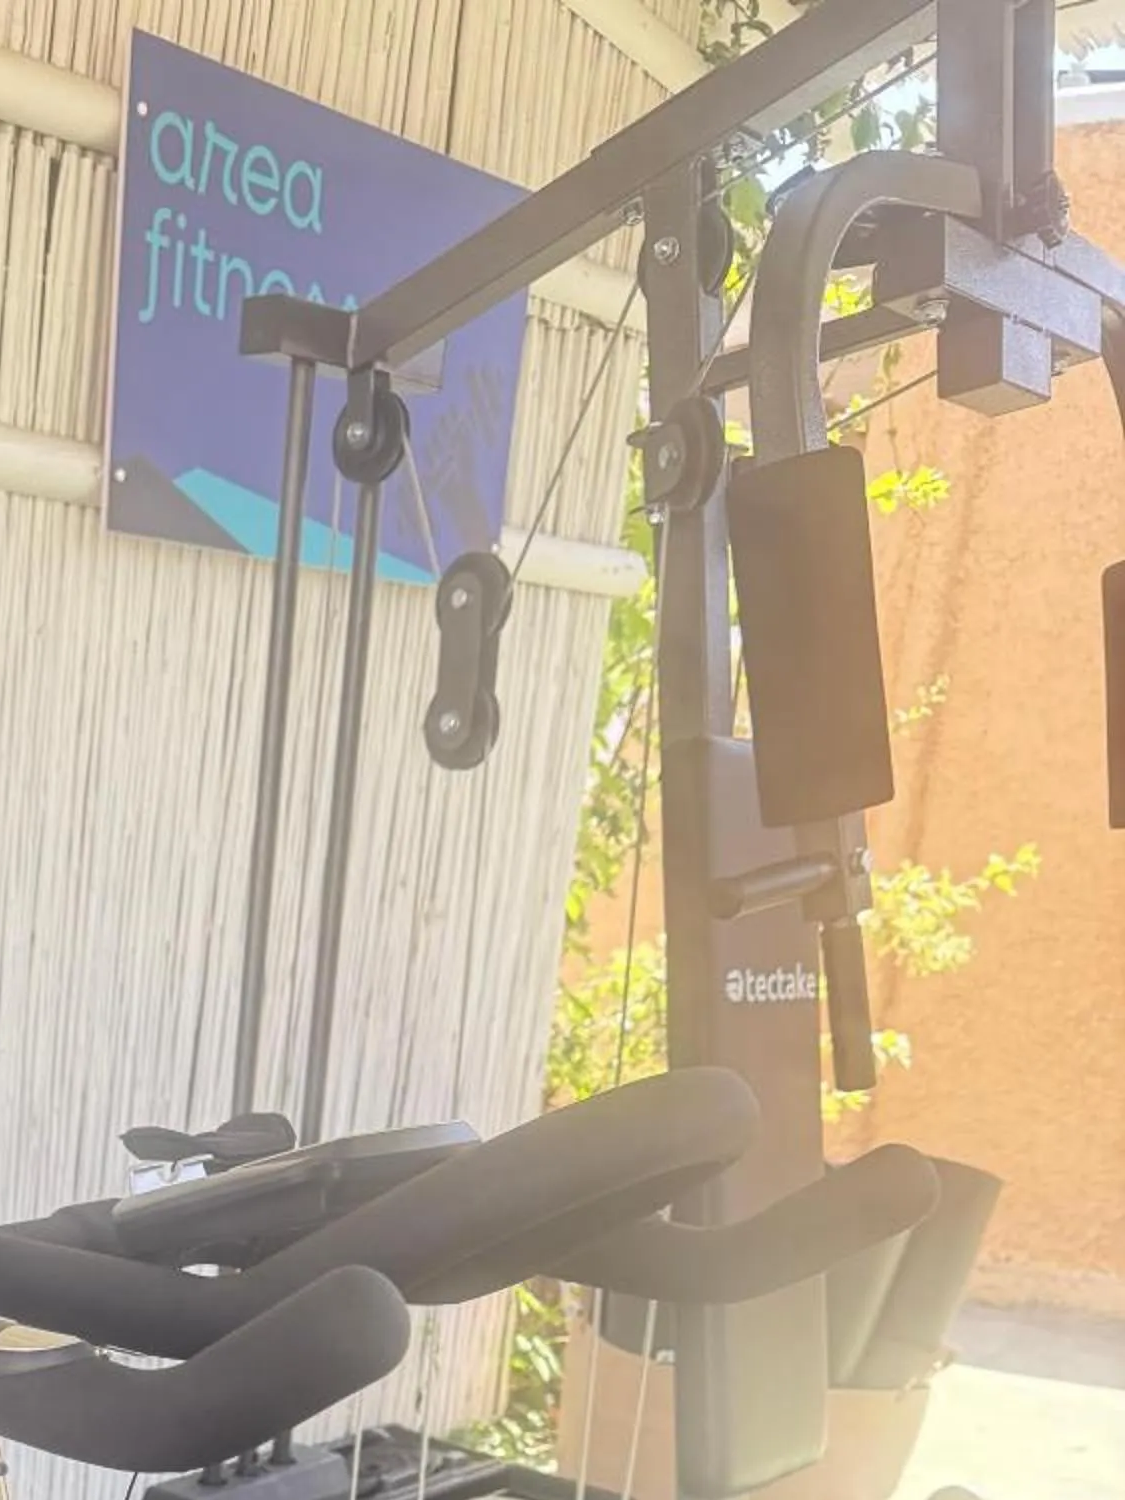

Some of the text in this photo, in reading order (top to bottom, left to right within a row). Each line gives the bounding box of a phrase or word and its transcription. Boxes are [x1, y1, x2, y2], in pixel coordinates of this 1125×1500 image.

[149, 111, 323, 234] area
[138, 207, 359, 323] fitn
[744, 961, 816, 1002] tectake
